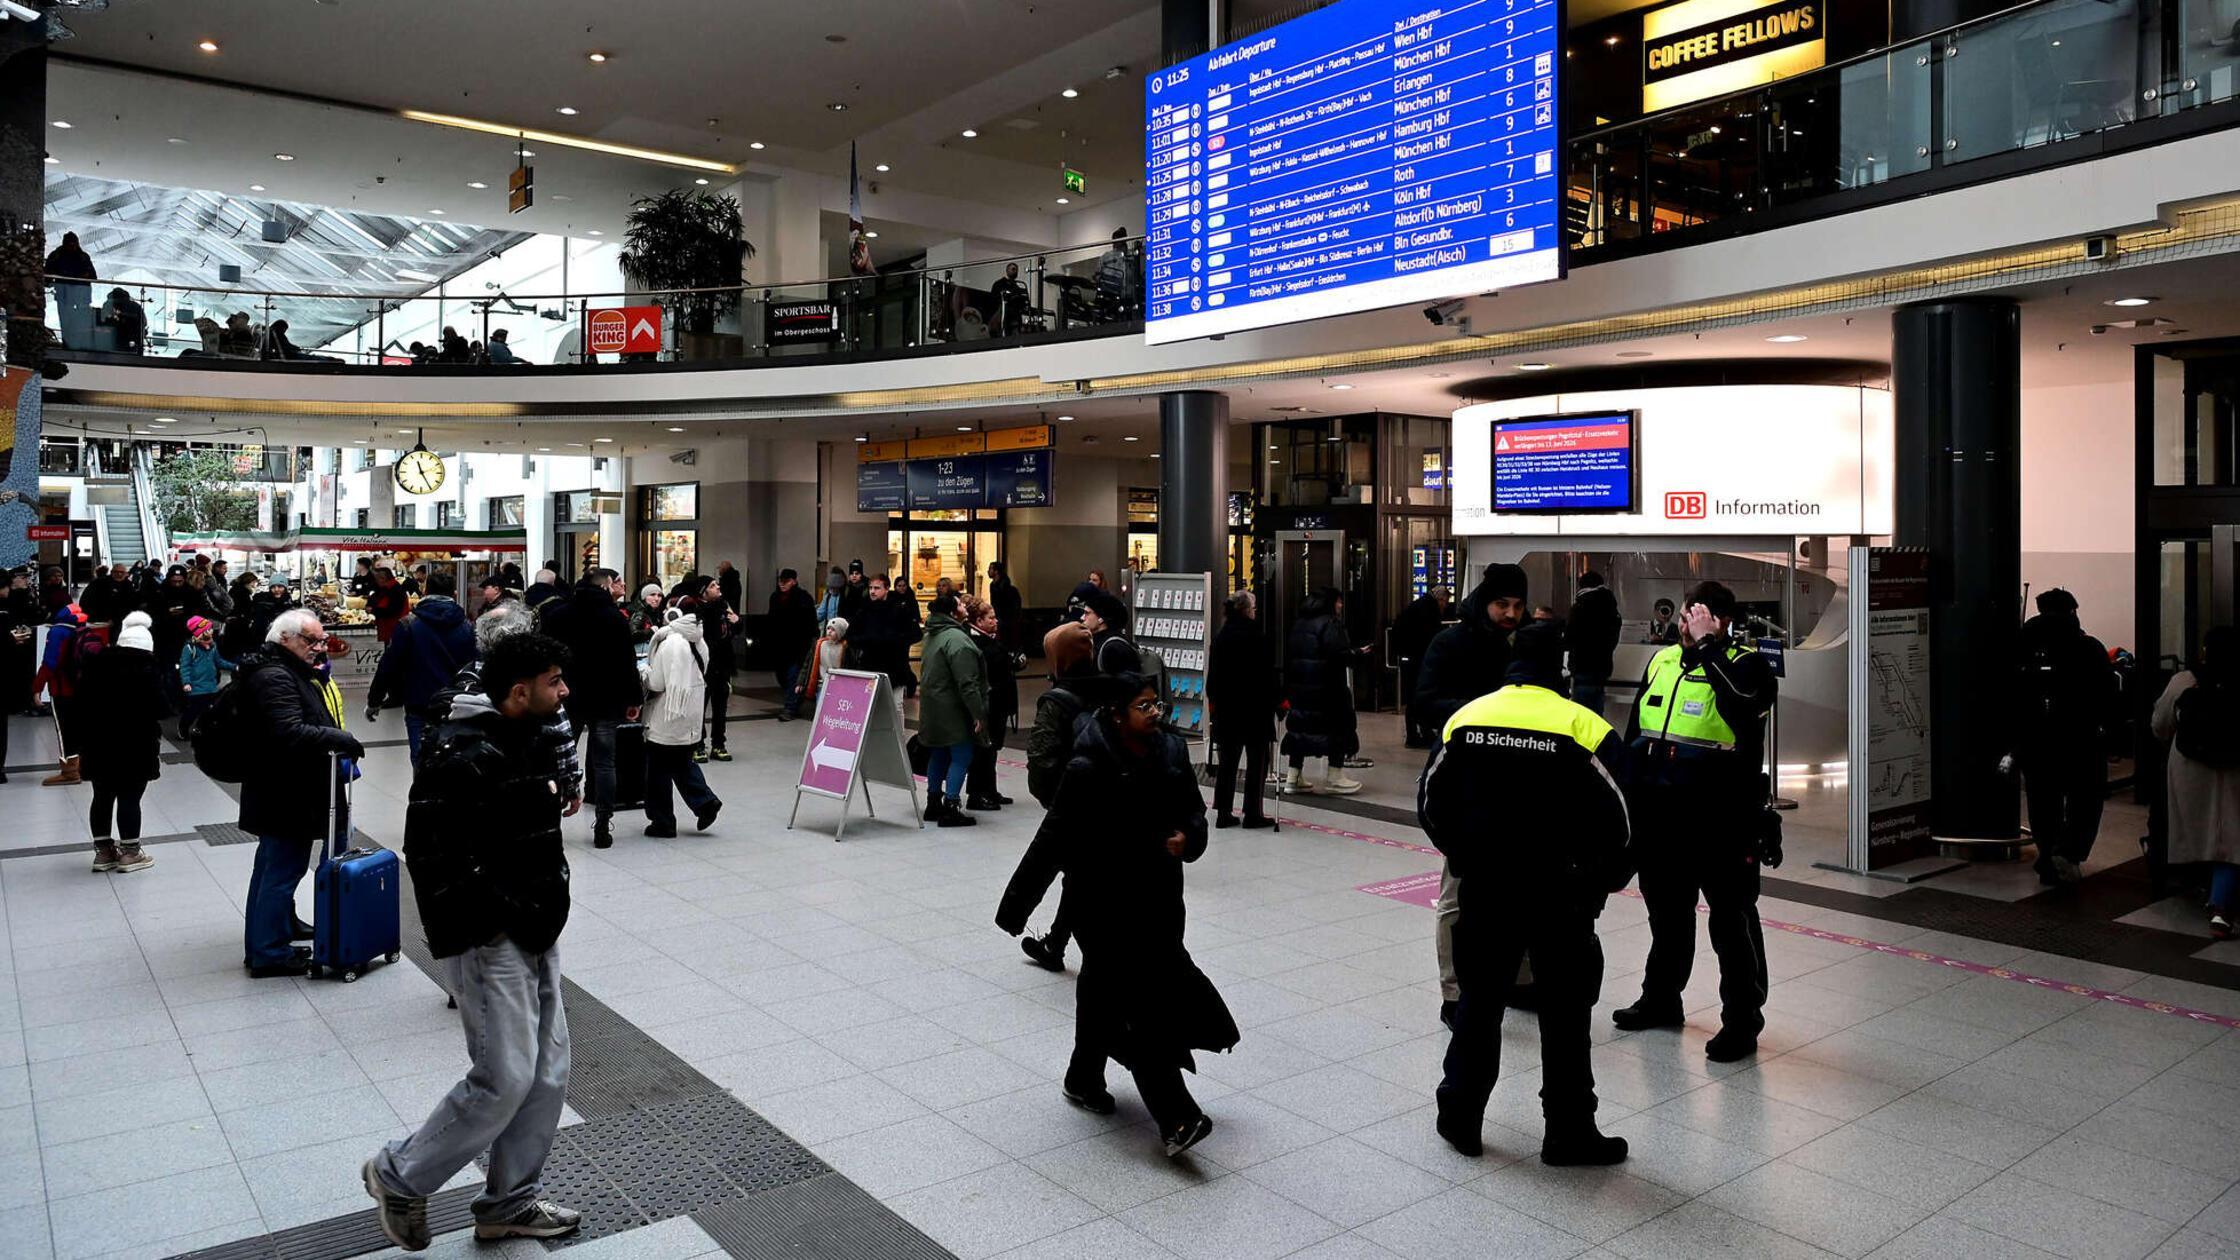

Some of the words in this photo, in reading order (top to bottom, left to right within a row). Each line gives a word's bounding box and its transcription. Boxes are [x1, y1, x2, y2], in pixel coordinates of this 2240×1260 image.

[1506, 20, 1514, 35] 9
[1394, 34, 1415, 49] Wien
[1416, 24, 1432, 42] Hbf
[1649, 32, 1718, 70] COFFEE
[1722, 5, 1815, 51] FELLOWS
[1208, 51, 1238, 72] Abfahrt
[1238, 38, 1276, 60] Departure
[1394, 51, 1432, 72] München
[1435, 40, 1451, 58] Hbf
[1506, 44, 1514, 59] 1
[1167, 68, 1189, 87] 11:25
[1394, 73, 1432, 94] Erlangen
[1506, 68, 1514, 83] 8
[1394, 96, 1432, 116] München
[1435, 86, 1451, 104] Hbf
[1506, 92, 1514, 106] 6
[1394, 120, 1432, 138] Hamburg
[1434, 110, 1450, 128] Hbf
[1506, 116, 1514, 131] 9
[1152, 134, 1171, 150] 11:01
[1394, 140, 1432, 160] München
[1435, 133, 1451, 151] Hbf
[1506, 141, 1514, 155] 1
[1394, 167, 1414, 183] Roth
[1506, 164, 1514, 179] 7
[1394, 190, 1414, 205] Köln
[1416, 184, 1431, 198] Hbf
[1506, 188, 1514, 203] 3
[1394, 208, 1434, 228] Altdorf(b
[1436, 194, 1482, 218] Nürnberg)
[1506, 213, 1514, 227] 6
[1394, 236, 1408, 250] Bln
[1410, 227, 1453, 245] Gesundbr.
[1394, 245, 1466, 272] Neustadt(Aisch)
[774, 304, 830, 317] SPORTSBAR
[594, 323, 624, 331] BURGER
[784, 327, 830, 336] Obergeschoss
[594, 332, 624, 343] KING
[938, 461, 953, 474] 1-23
[945, 477, 956, 486] den
[957, 476, 974, 488] Zügen
[1670, 496, 1702, 516] DB
[1716, 499, 1820, 516] Information
[838, 699, 853, 711] SEV-
[822, 715, 862, 734] Wegeleitung
[1466, 732, 1484, 744] DB
[1487, 733, 1557, 752] Sicherheit
